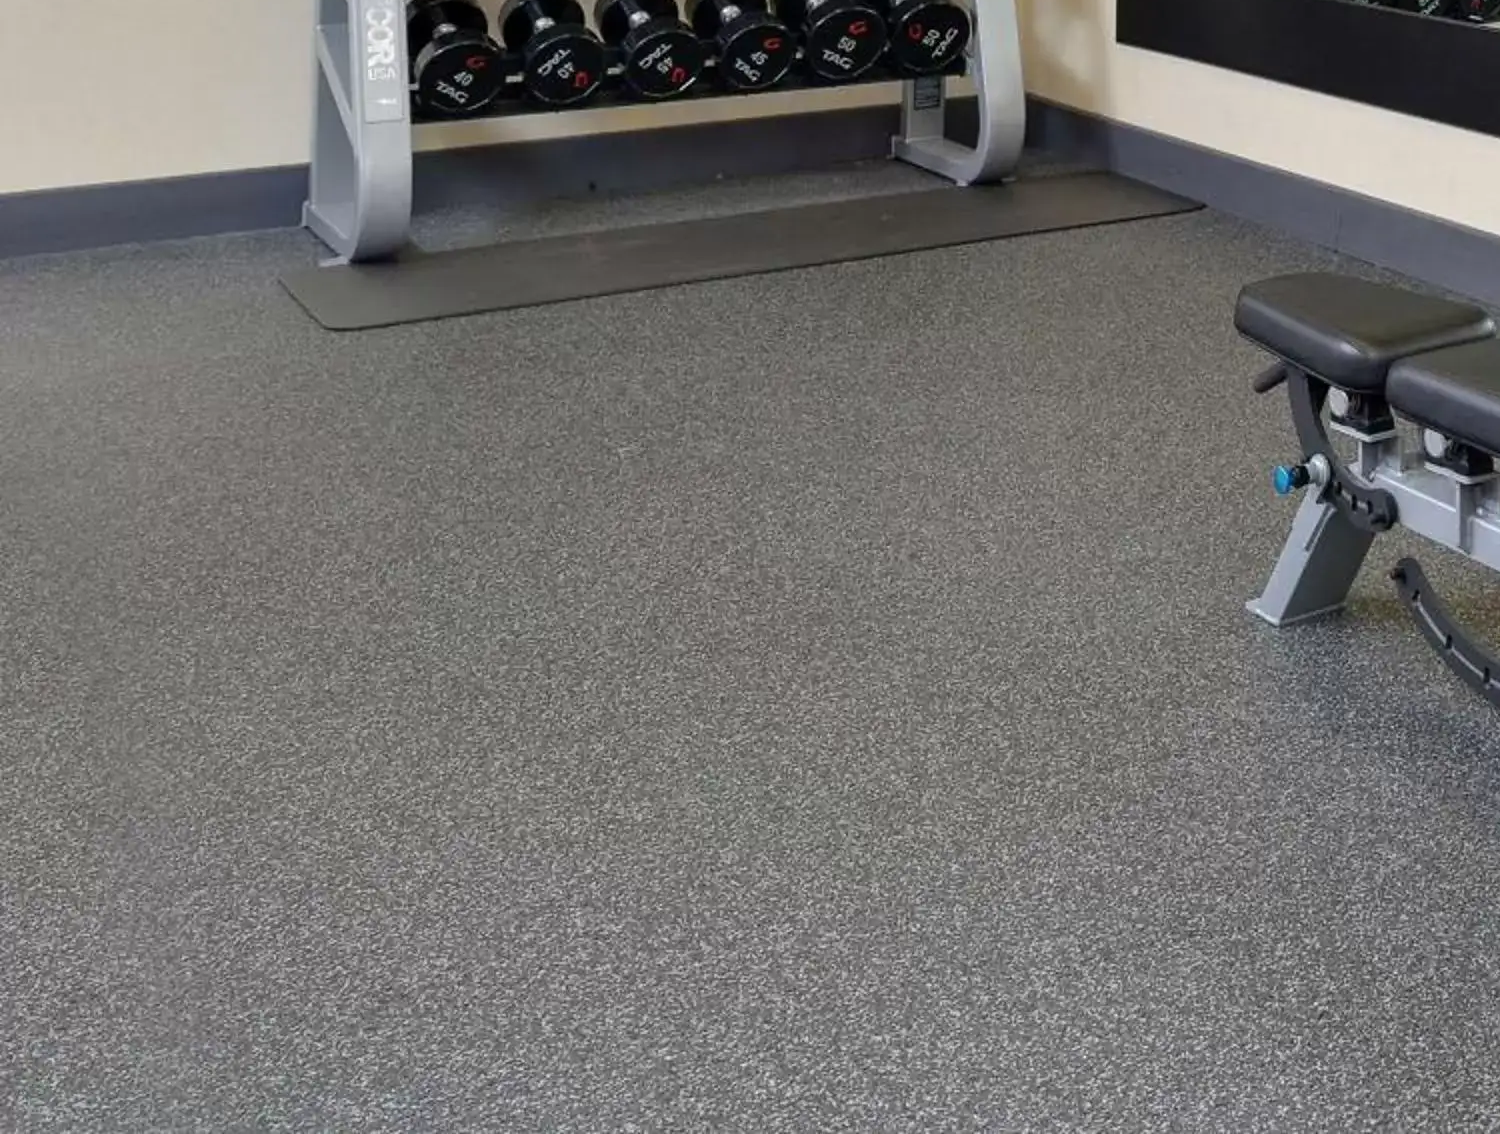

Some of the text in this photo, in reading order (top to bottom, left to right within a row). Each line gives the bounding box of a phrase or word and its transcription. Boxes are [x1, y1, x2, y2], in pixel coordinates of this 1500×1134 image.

[837, 35, 857, 53] 50
[931, 27, 959, 59] TAG
[537, 48, 572, 77] TAG
[638, 43, 673, 69] TAG
[750, 51, 769, 66] 45
[822, 49, 855, 70] TAG
[453, 71, 474, 86] 40
[735, 57, 761, 83] TAG
[436, 80, 470, 104] TAG
